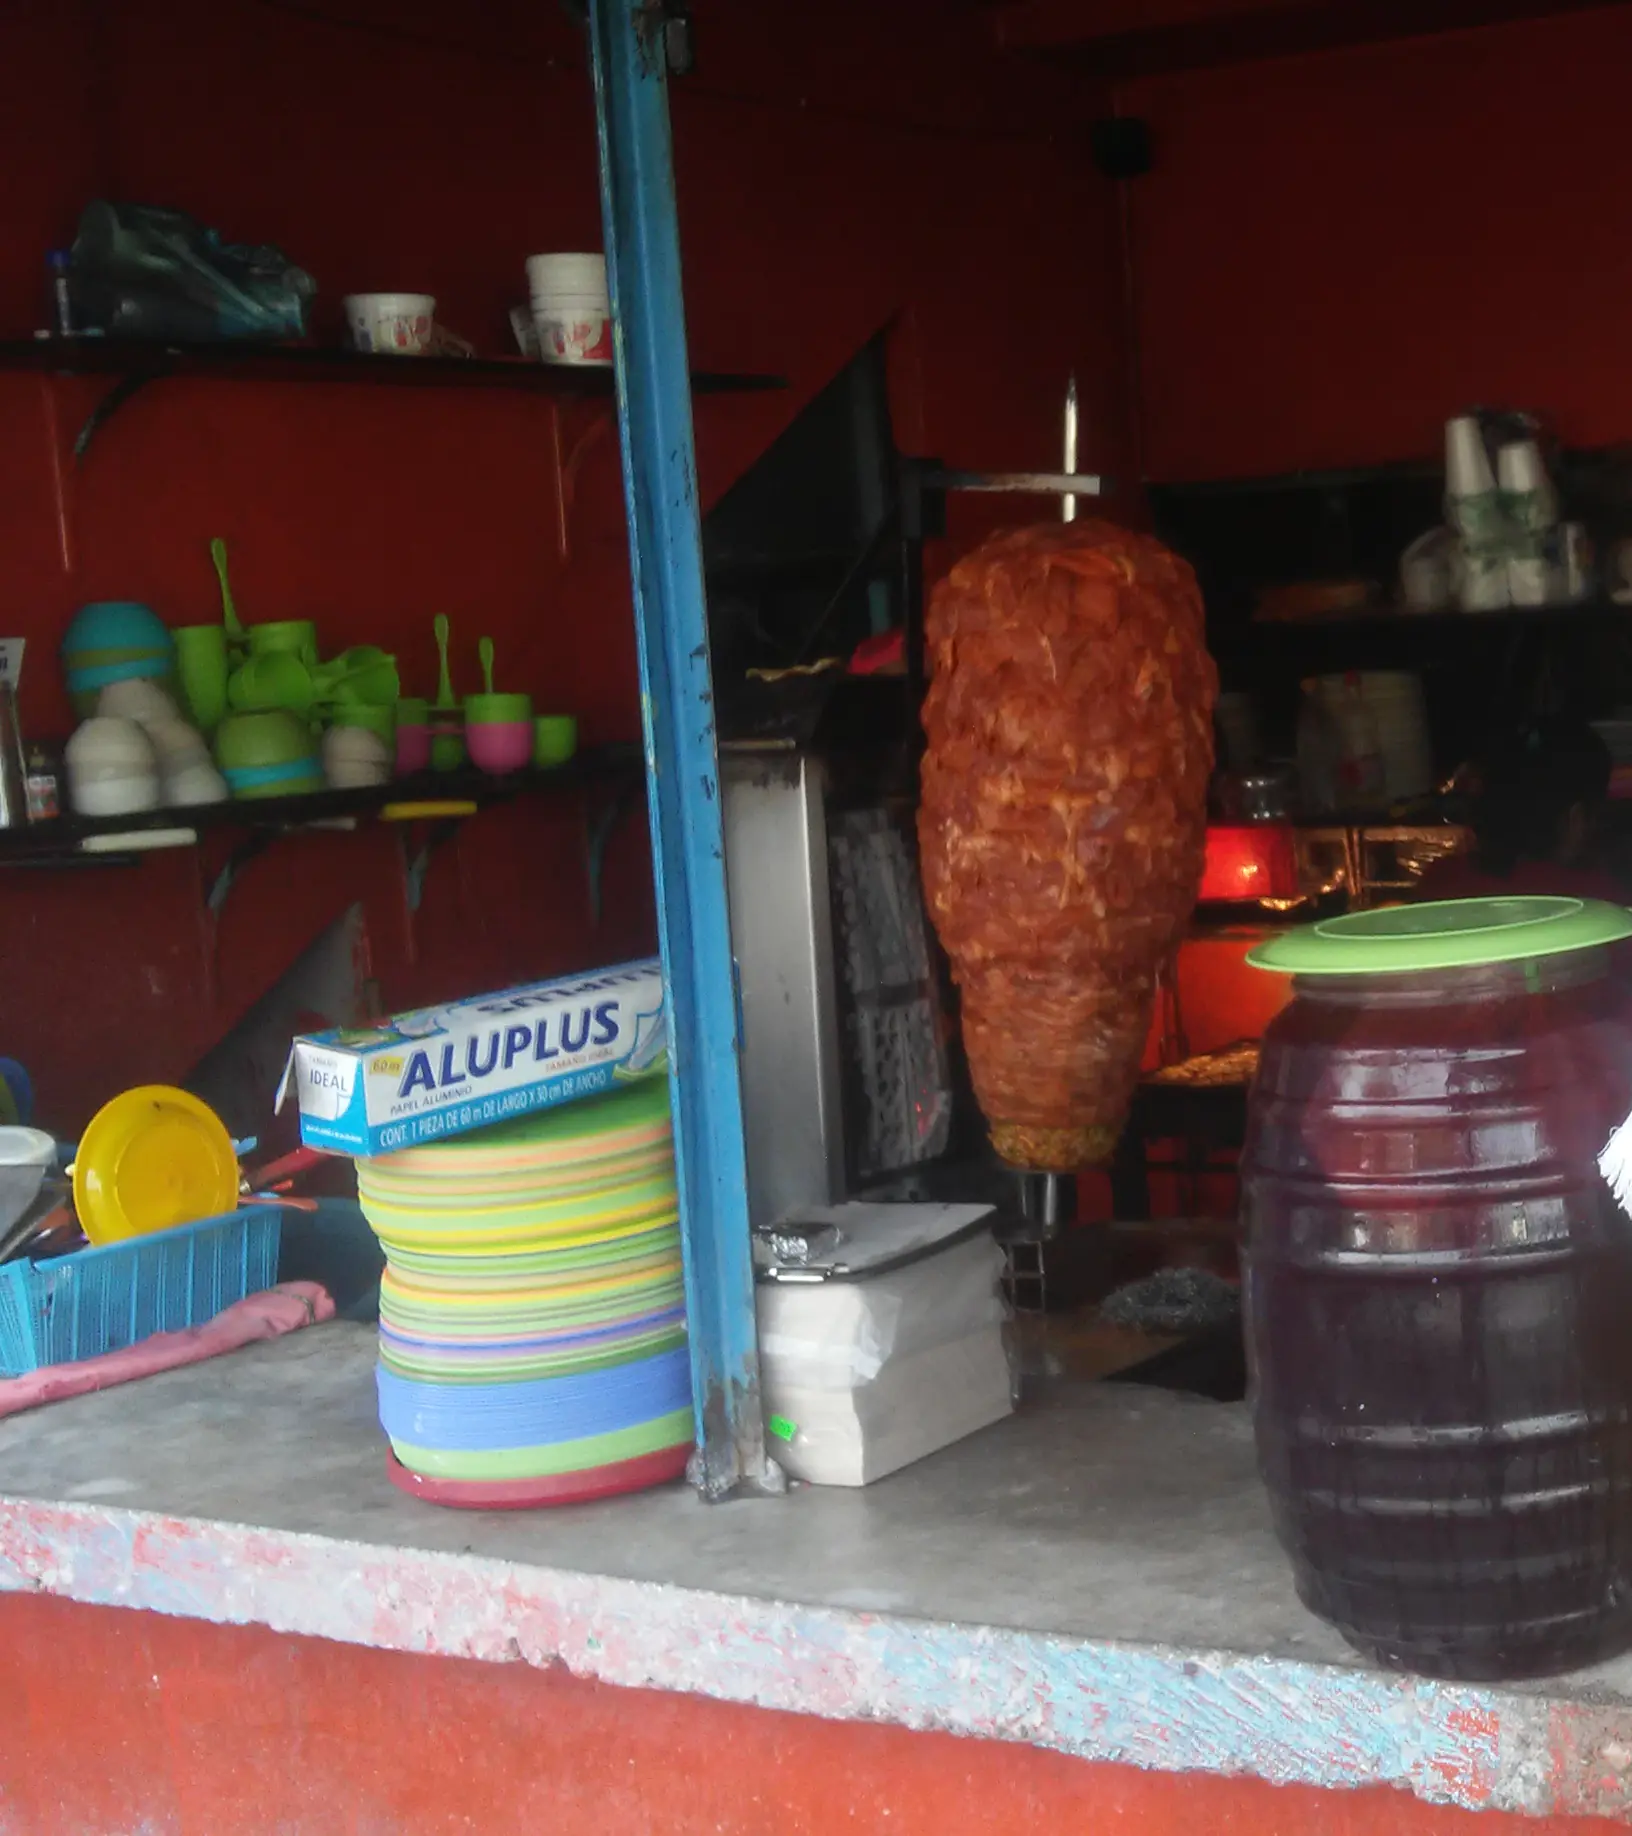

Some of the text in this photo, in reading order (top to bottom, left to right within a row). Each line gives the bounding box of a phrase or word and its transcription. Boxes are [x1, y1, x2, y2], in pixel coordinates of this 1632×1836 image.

[397, 1001, 620, 1098] ALUPLUS
[309, 1068, 348, 1092] IDEAL
[390, 1085, 473, 1116] PAPEL ALUMINIO
[412, 1120, 417, 1140] 1
[419, 1115, 444, 1137] PIEZA
[446, 1110, 458, 1129] DE
[460, 1105, 472, 1125] 60
[483, 1101, 495, 1119] DE
[497, 1091, 528, 1114] LARGO
[562, 1078, 574, 1097] DE
[575, 1068, 607, 1092] ANCHO
